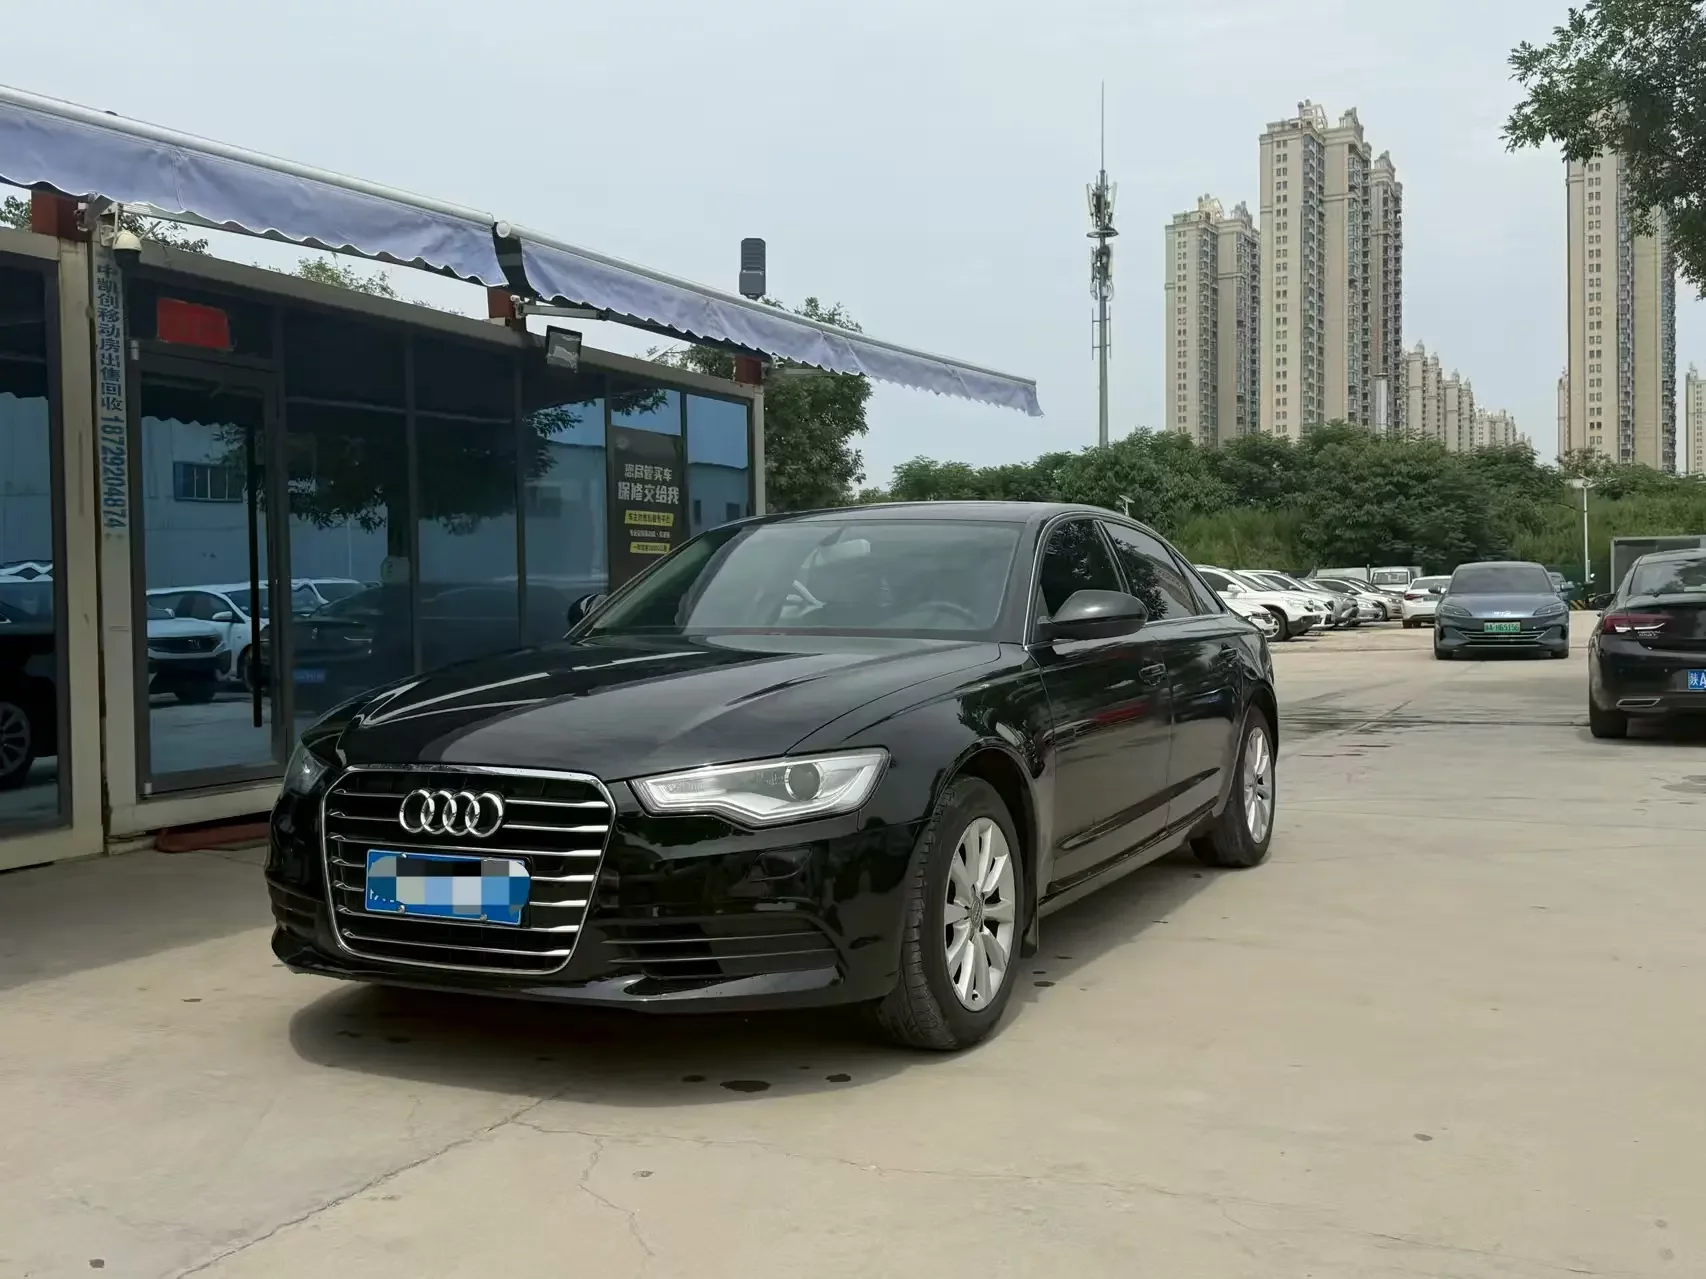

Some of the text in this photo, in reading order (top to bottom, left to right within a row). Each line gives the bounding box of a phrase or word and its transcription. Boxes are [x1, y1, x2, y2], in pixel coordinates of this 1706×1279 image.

[101, 416, 127, 528] 18729204874
[625, 464, 672, 482] 您尽管买车
[618, 481, 680, 504] 保修交给我
